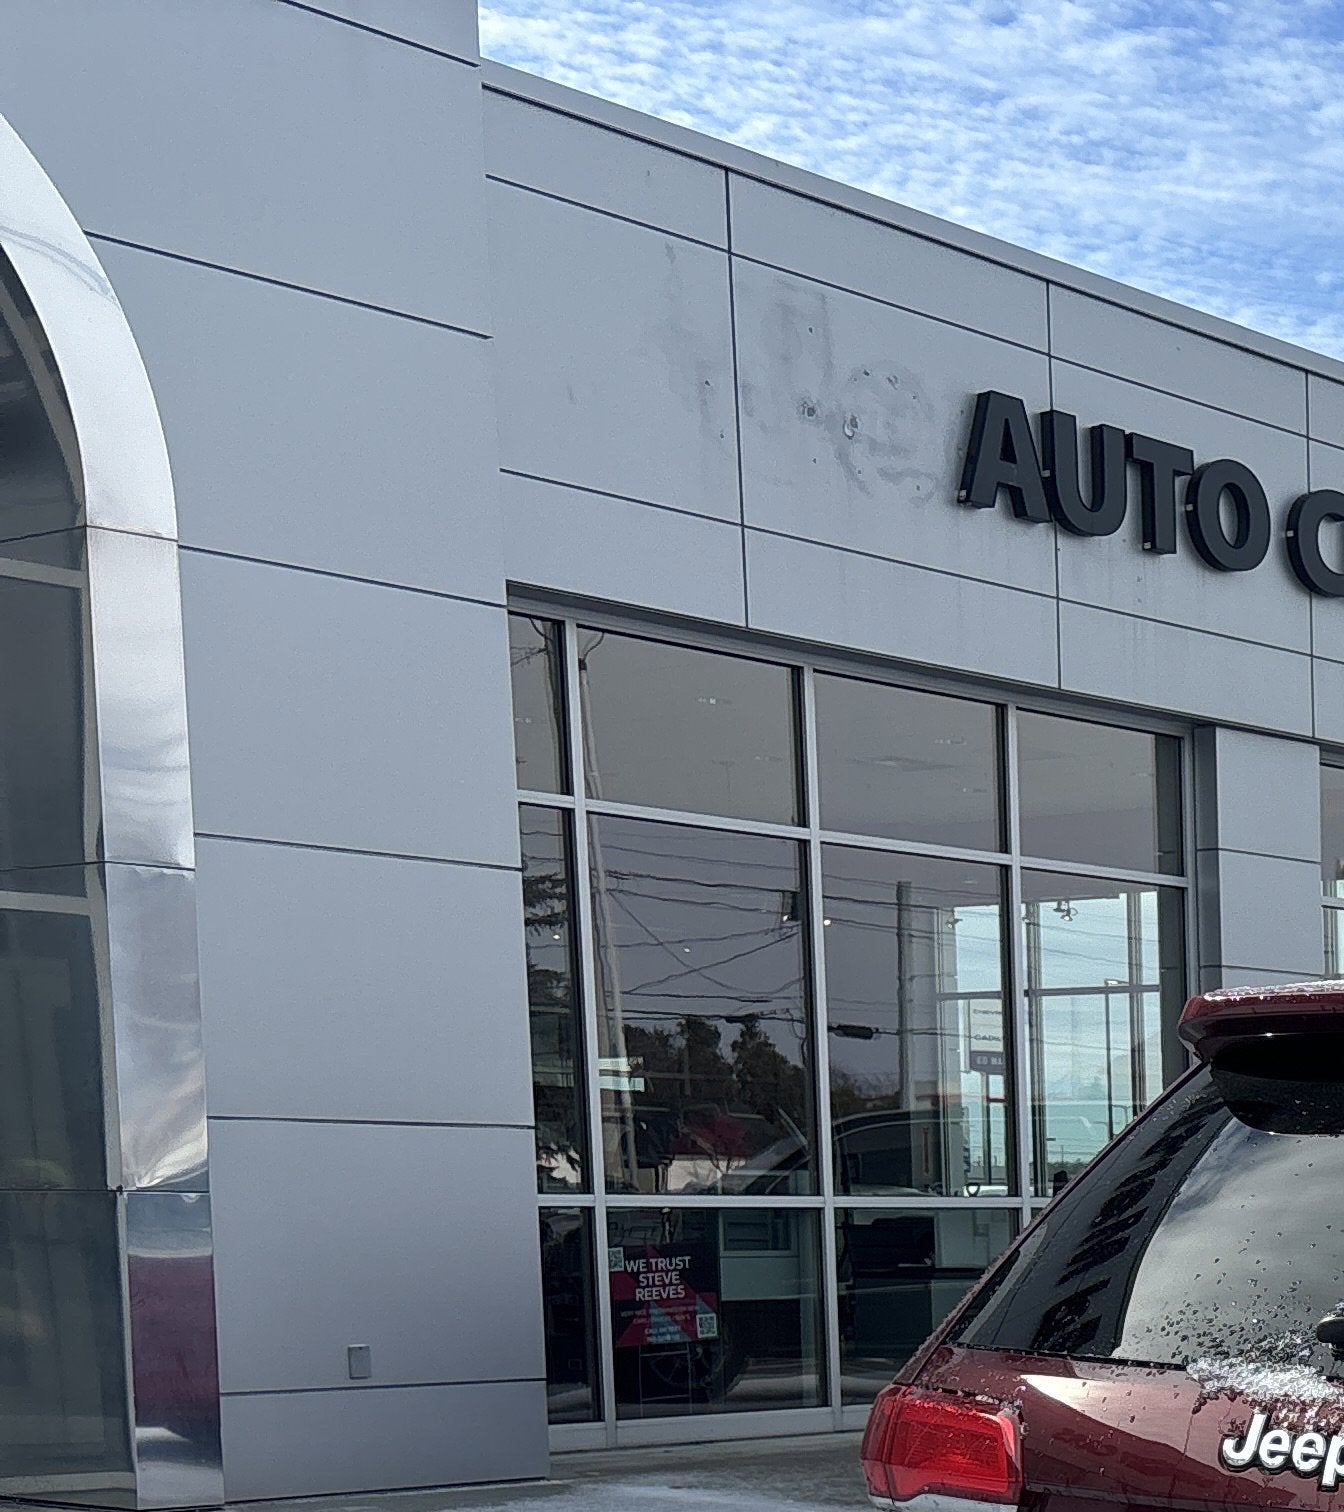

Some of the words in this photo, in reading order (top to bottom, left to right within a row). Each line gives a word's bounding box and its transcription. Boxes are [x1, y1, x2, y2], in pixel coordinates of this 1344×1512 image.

[957, 390, 1271, 572] AUTO
[625, 1259, 648, 1273] WE
[649, 1256, 691, 1271] TRUST
[639, 1271, 681, 1286] STEVE
[635, 1285, 686, 1302] REEVES
